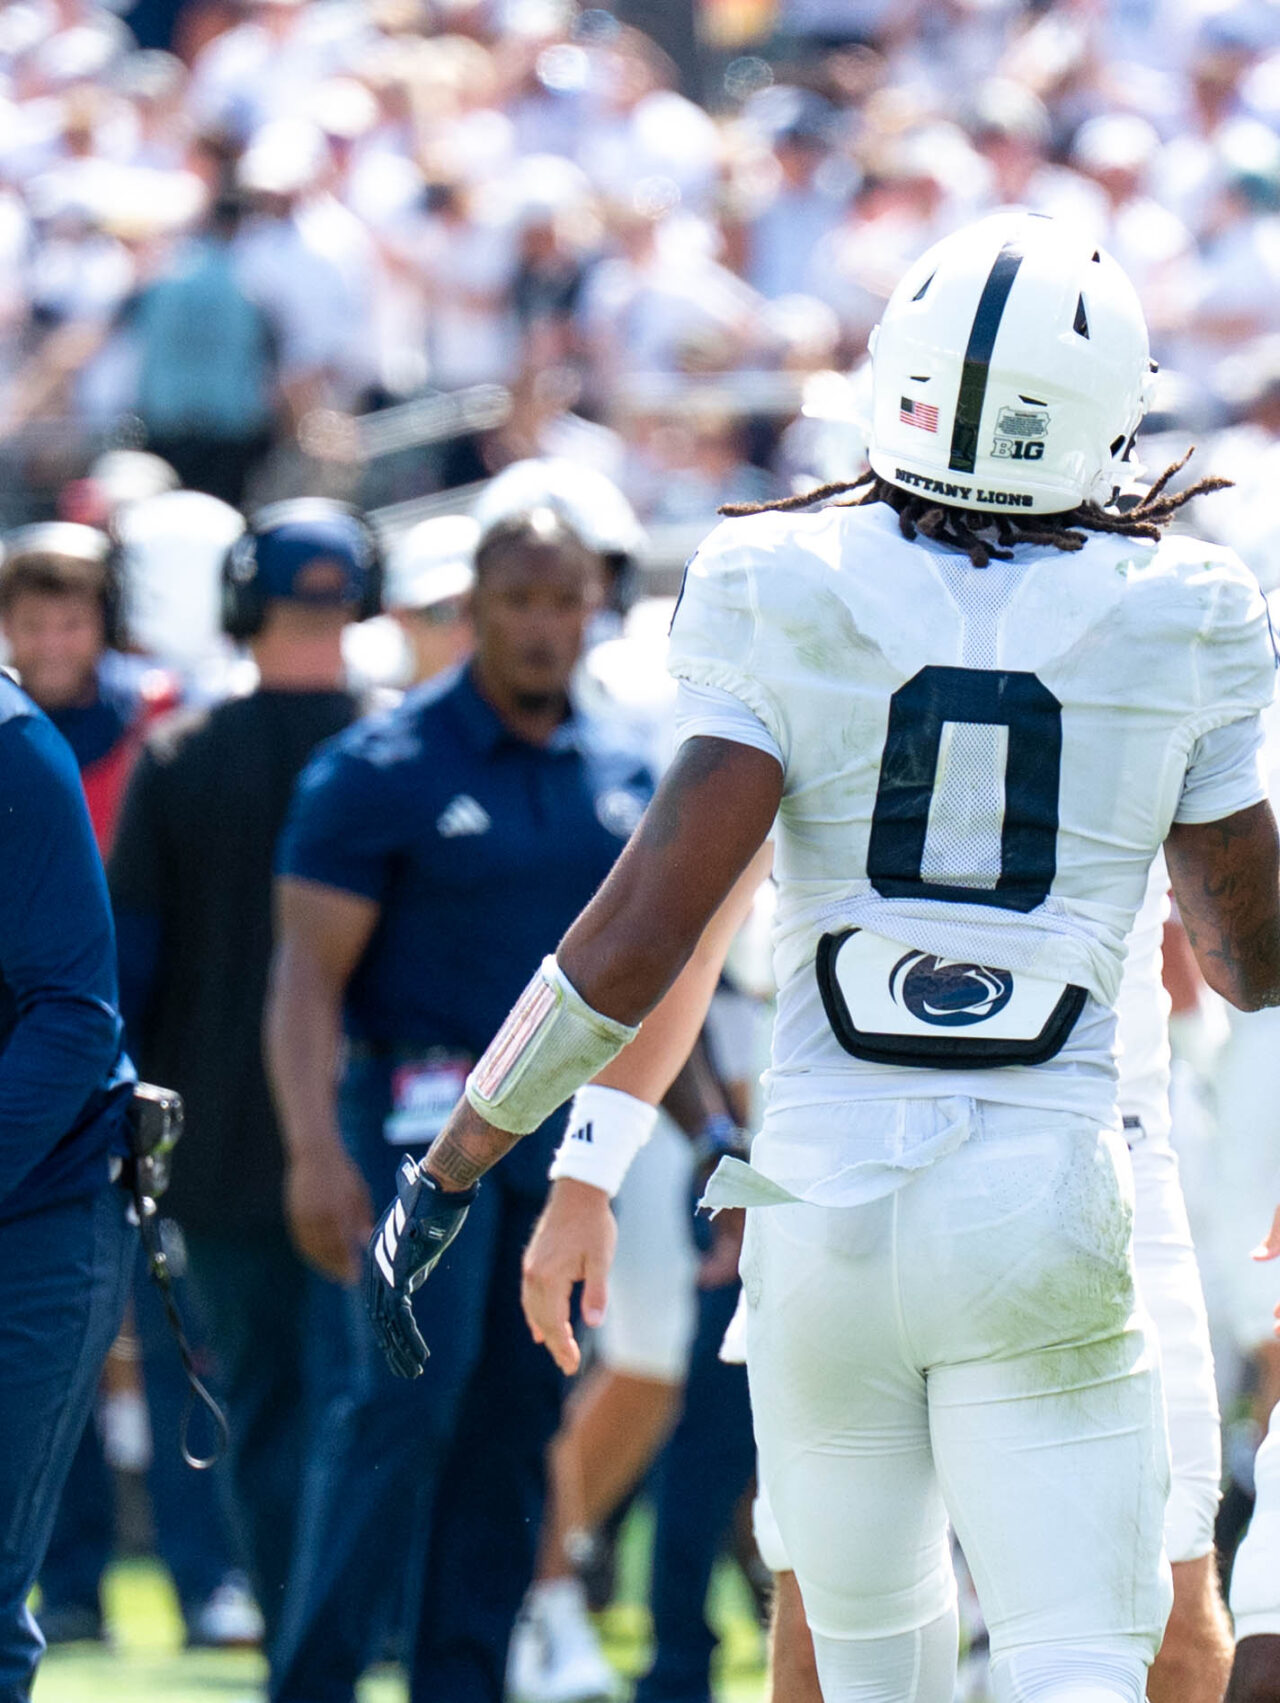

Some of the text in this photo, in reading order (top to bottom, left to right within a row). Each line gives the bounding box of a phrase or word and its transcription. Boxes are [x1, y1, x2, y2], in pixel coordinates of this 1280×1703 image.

[895, 468, 1033, 507] NITTANY LIONS
[867, 665, 1062, 913] 0
